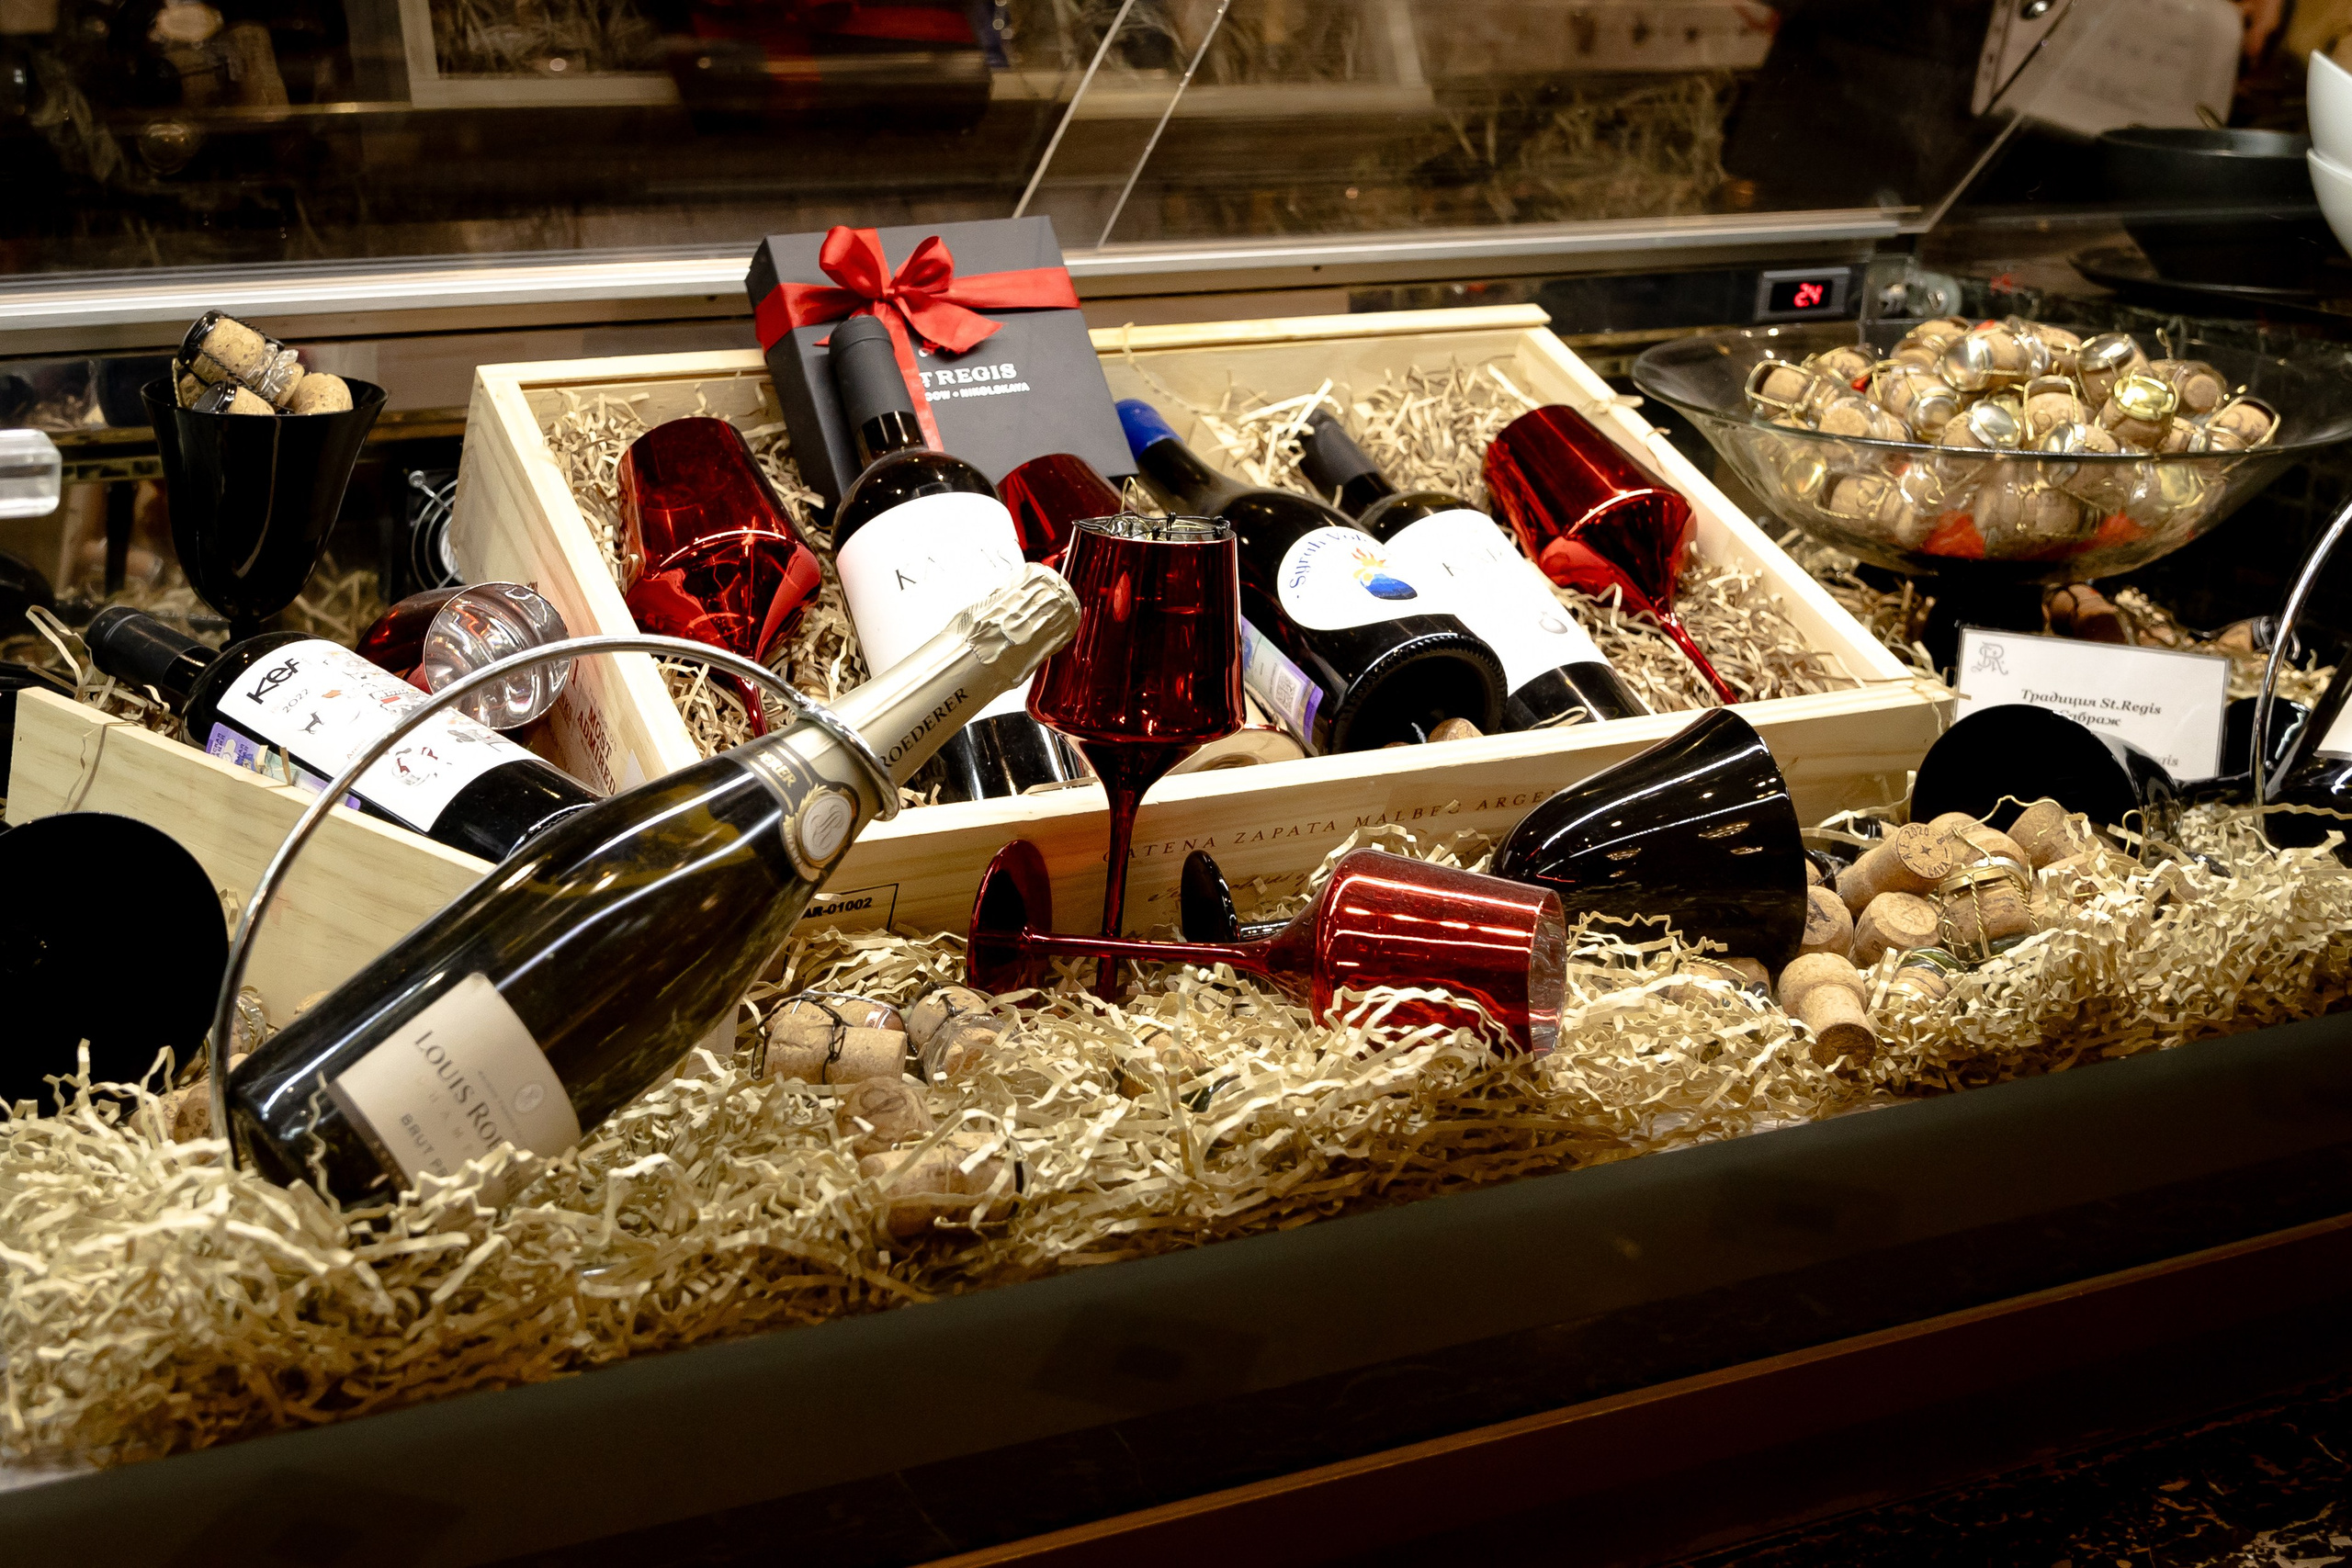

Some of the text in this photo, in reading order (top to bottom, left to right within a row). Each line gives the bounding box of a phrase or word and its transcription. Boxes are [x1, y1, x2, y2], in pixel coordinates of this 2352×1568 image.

[1793, 282, 1824, 308] 24
[935, 363, 1017, 386] REGIS
[2021, 688, 2162, 716] Традиция St.Regis
[588, 704, 614, 761] MOST
[577, 710, 616, 797] ADMIRED
[1234, 819, 1337, 845] ZAPATA
[415, 1030, 476, 1105] LOUIS
[400, 1112, 435, 1156] BRUT
